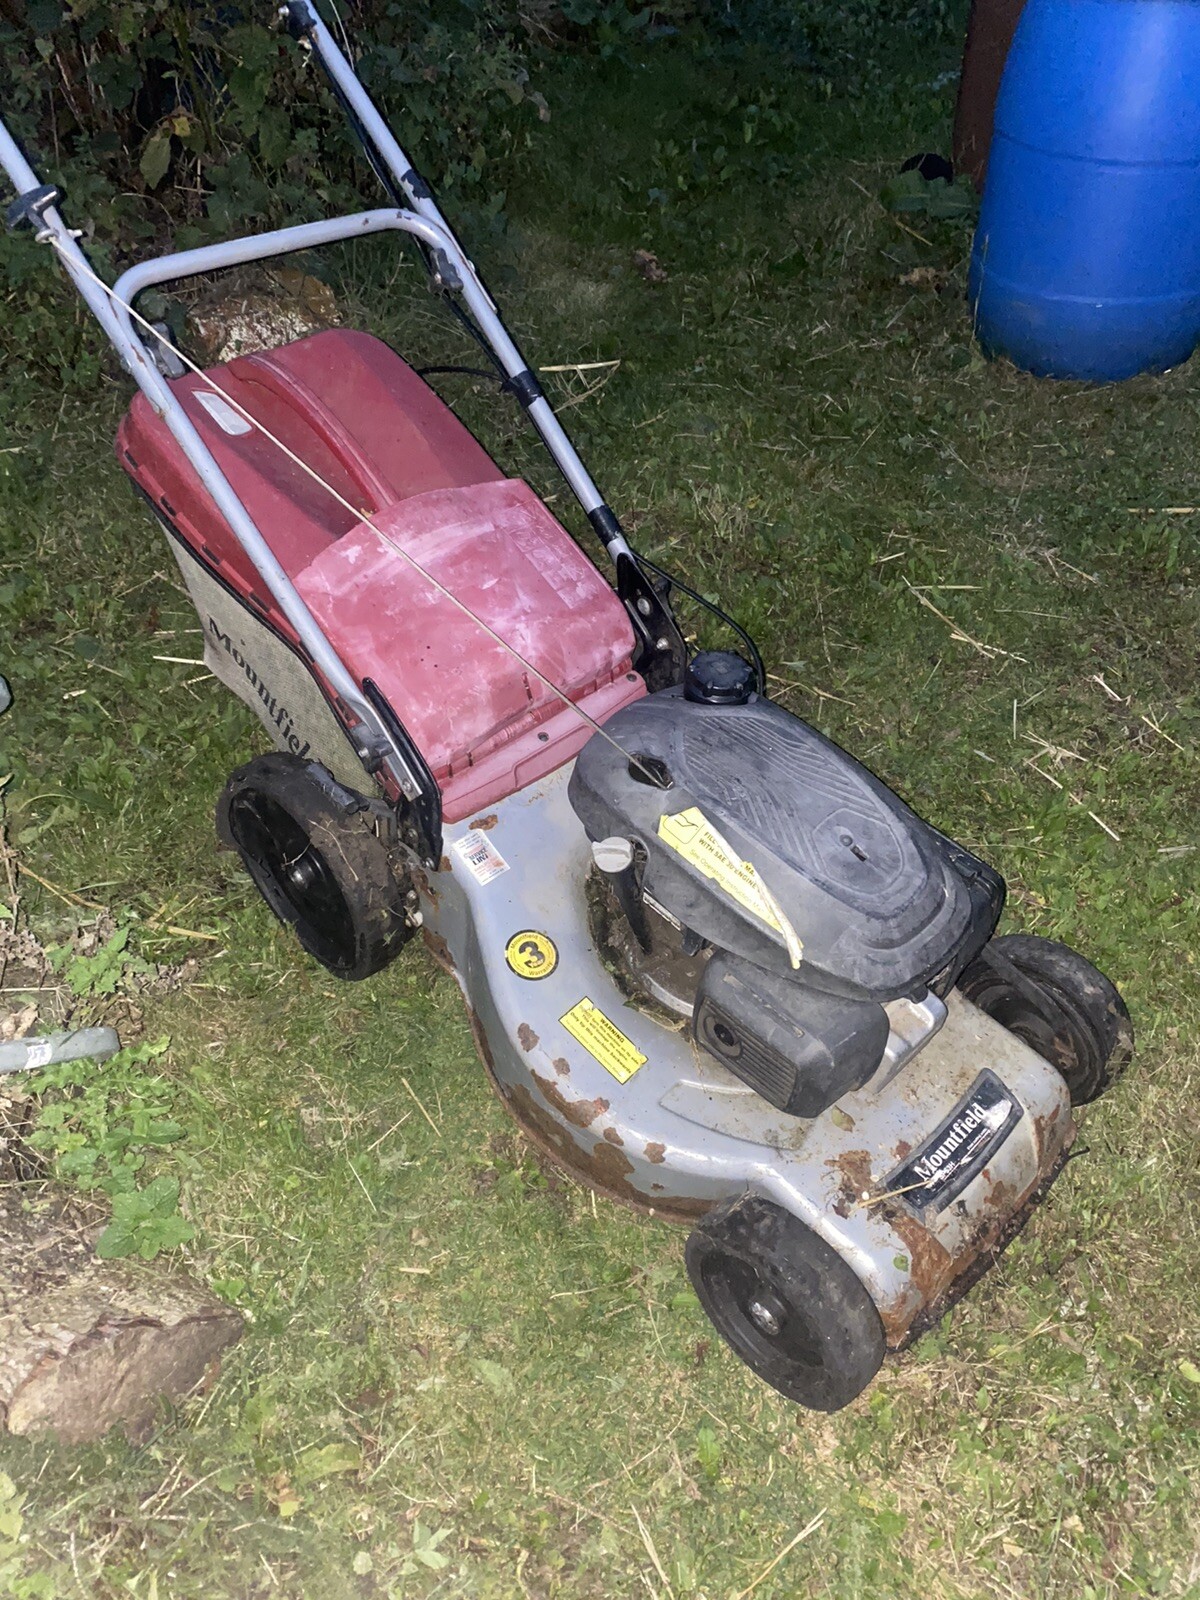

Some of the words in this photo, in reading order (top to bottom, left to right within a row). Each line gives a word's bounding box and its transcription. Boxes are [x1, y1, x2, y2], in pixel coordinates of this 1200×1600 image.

[207, 614, 311, 757] Mountfiel
[697, 837, 715, 853] WITH
[712, 850, 727, 864] SAE
[732, 866, 758, 890] ENGINE
[744, 865, 755, 876] MA
[519, 940, 544, 968] 3
[600, 1018, 624, 1043] WARNING
[913, 1102, 987, 1181] Mountfield
